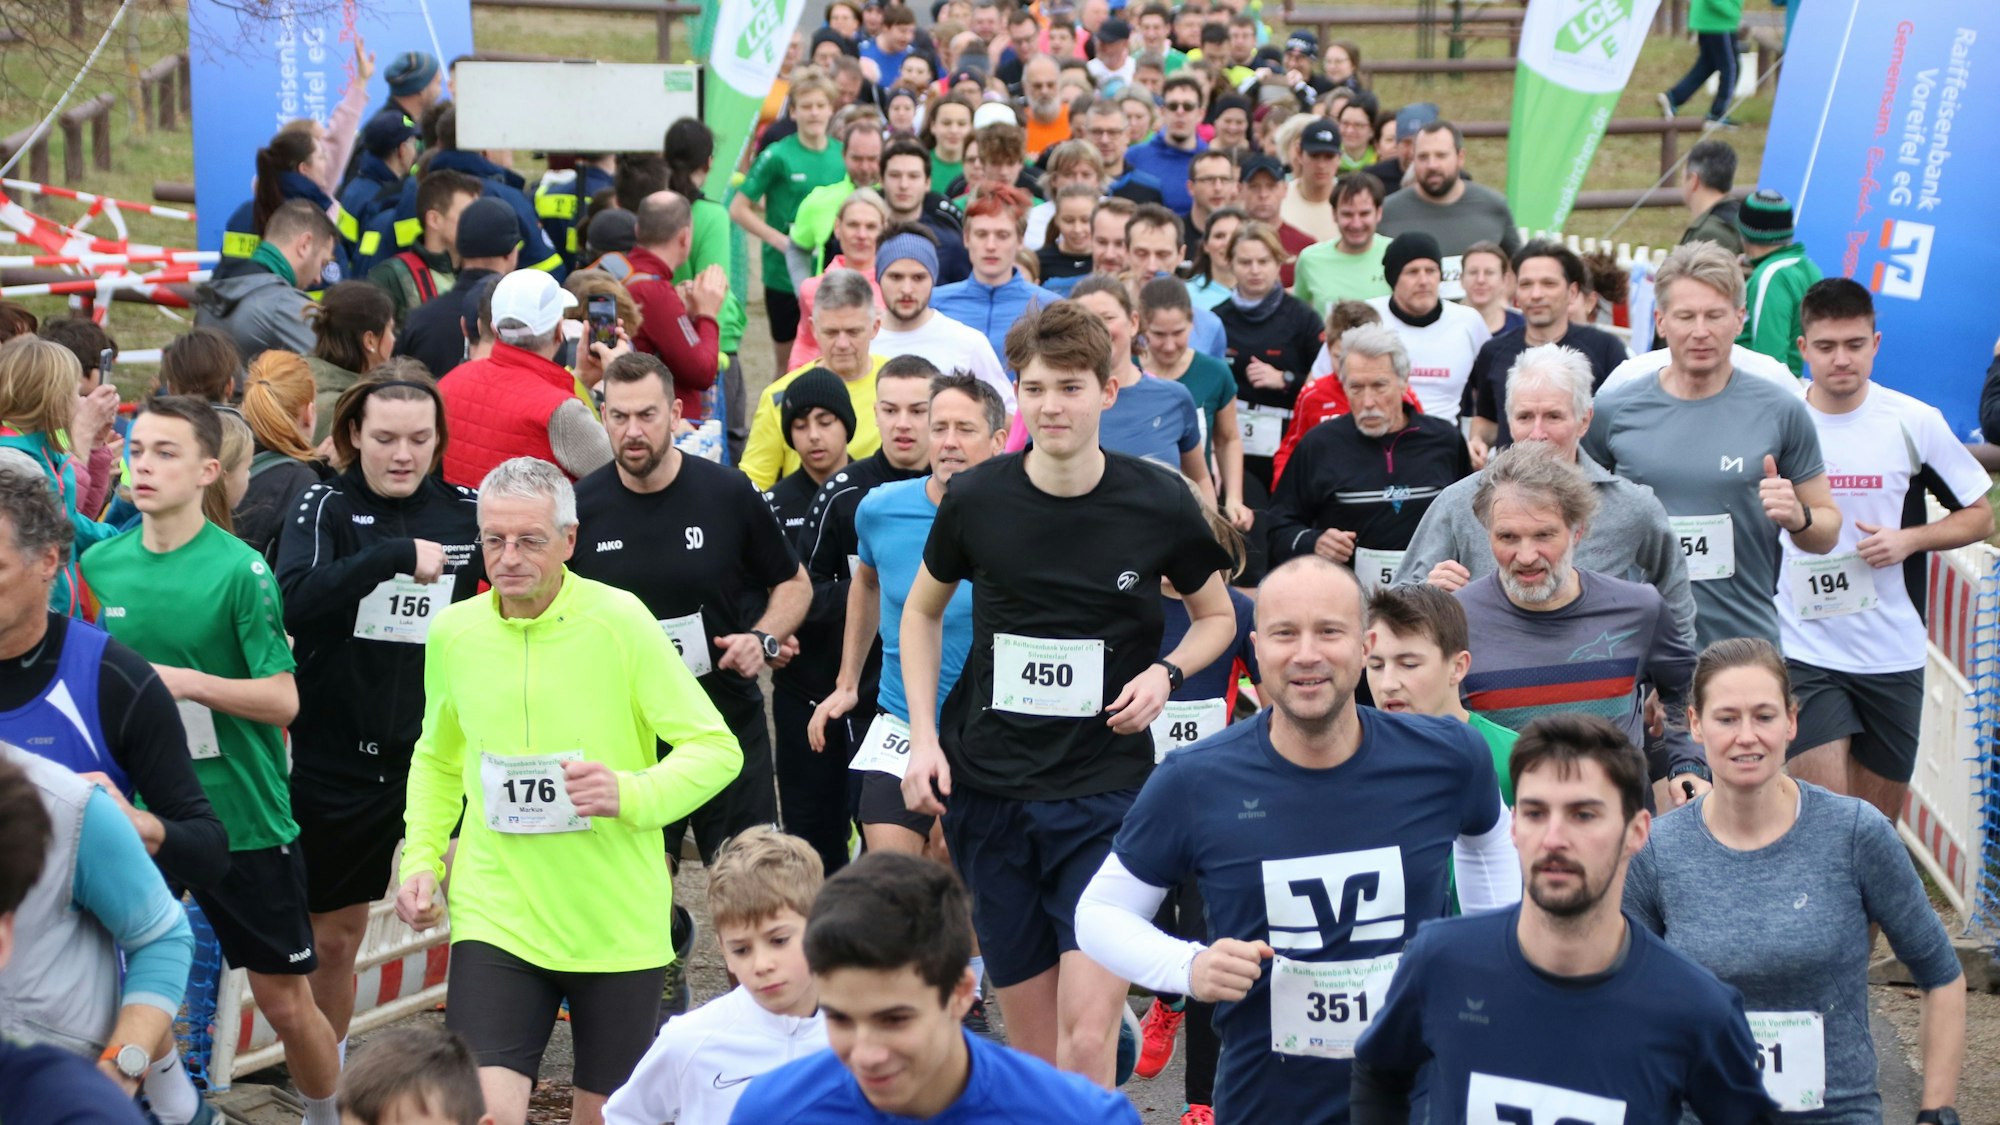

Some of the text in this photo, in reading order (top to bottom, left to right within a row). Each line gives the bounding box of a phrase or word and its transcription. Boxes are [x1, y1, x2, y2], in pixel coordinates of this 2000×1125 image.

[1916, 27, 1978, 212] Raiffeisenbank
[1888, 68, 1940, 207] Voreifel eG
[596, 540, 624, 552] JAKO
[685, 527, 704, 550] SD
[1381, 568, 1397, 584] 5
[1808, 572, 1850, 595] 194
[389, 594, 430, 617] 156
[1021, 661, 1073, 687] 450
[1169, 721, 1198, 741] 48
[358, 740, 379, 755] LG
[503, 778, 556, 803] 176
[1292, 966, 1351, 977] Raiffeisenbank
[1313, 980, 1365, 988] Silvesterlauf
[1307, 991, 1368, 1023] 351
[1768, 1018, 1799, 1027] Voreifel
